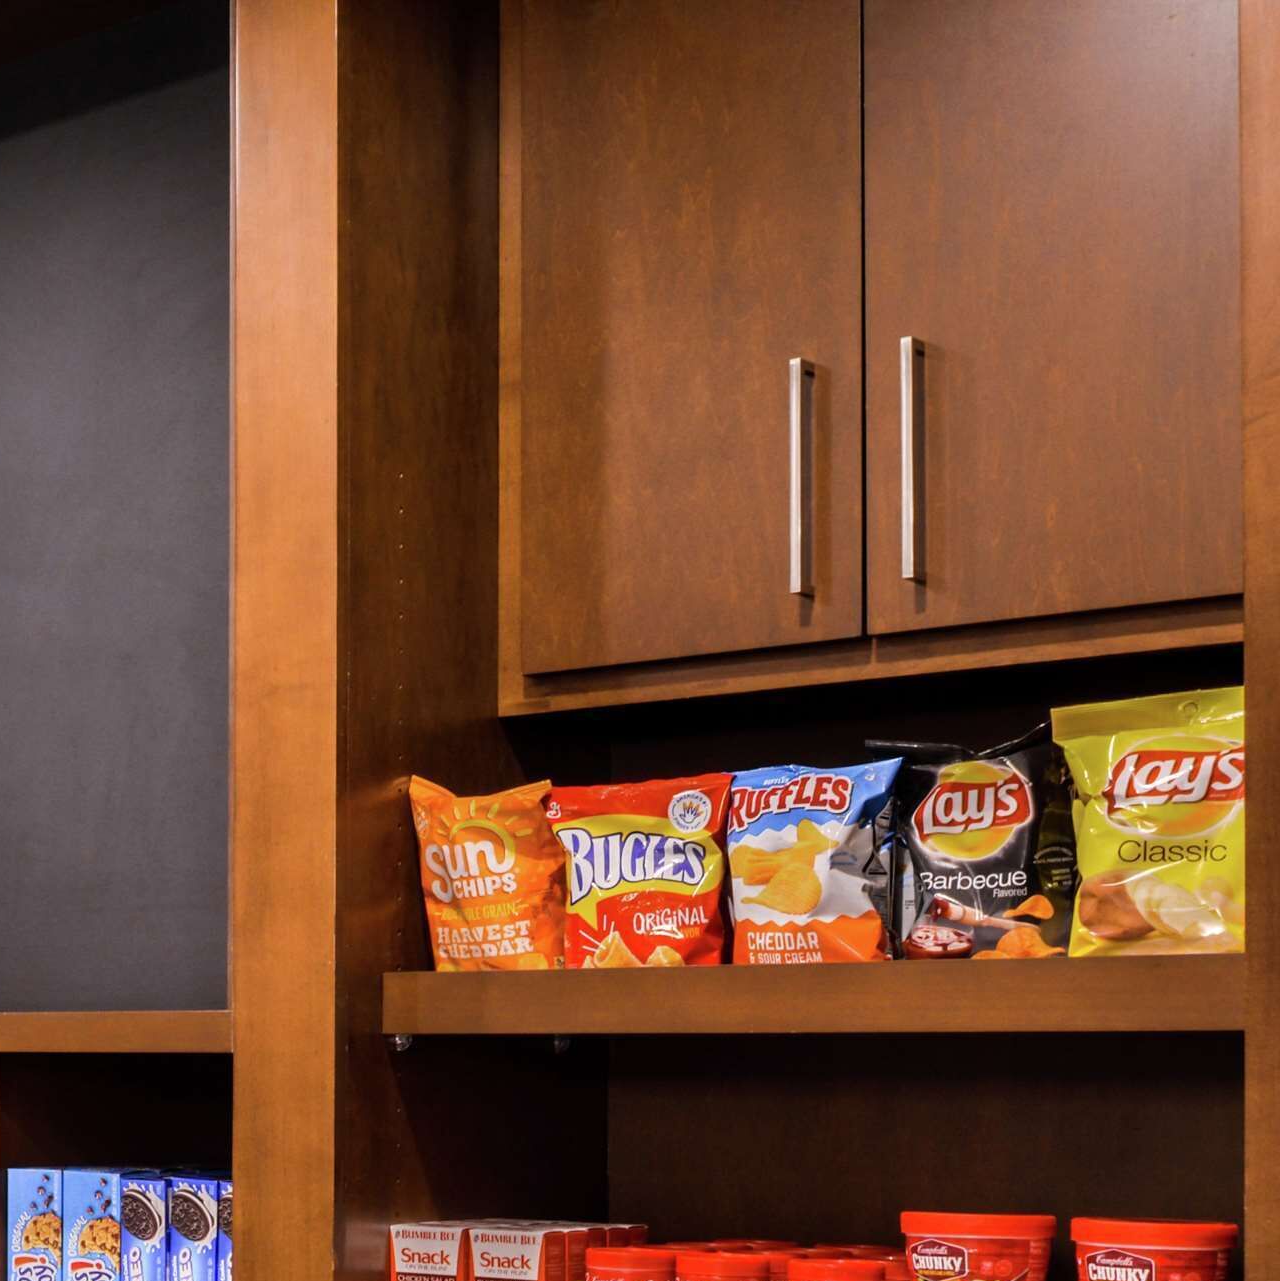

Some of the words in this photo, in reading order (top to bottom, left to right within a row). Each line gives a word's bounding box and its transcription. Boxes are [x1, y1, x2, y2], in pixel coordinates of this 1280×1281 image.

[1109, 749, 1244, 807] Lay's
[729, 776, 850, 830] RUFFLES
[921, 781, 1021, 833] Lay's
[1118, 840, 1228, 863] Classic
[556, 828, 705, 906] BUGLES
[453, 874, 517, 898] CHIPS
[920, 870, 1027, 892] Barbecue
[993, 887, 1028, 899] Flavored
[437, 920, 531, 944] HARVEST
[747, 932, 819, 950] CHEDDAR
[439, 937, 534, 959] CHEDDAR
[749, 953, 755, 963] &
[758, 952, 782, 964] SOUR
[784, 952, 823, 963] CREAM
[11, 1211, 32, 1252] ORIGINAL
[401, 1247, 450, 1265] Snack
[480, 1251, 531, 1270] Snack
[912, 1253, 963, 1271] CHUNKY
